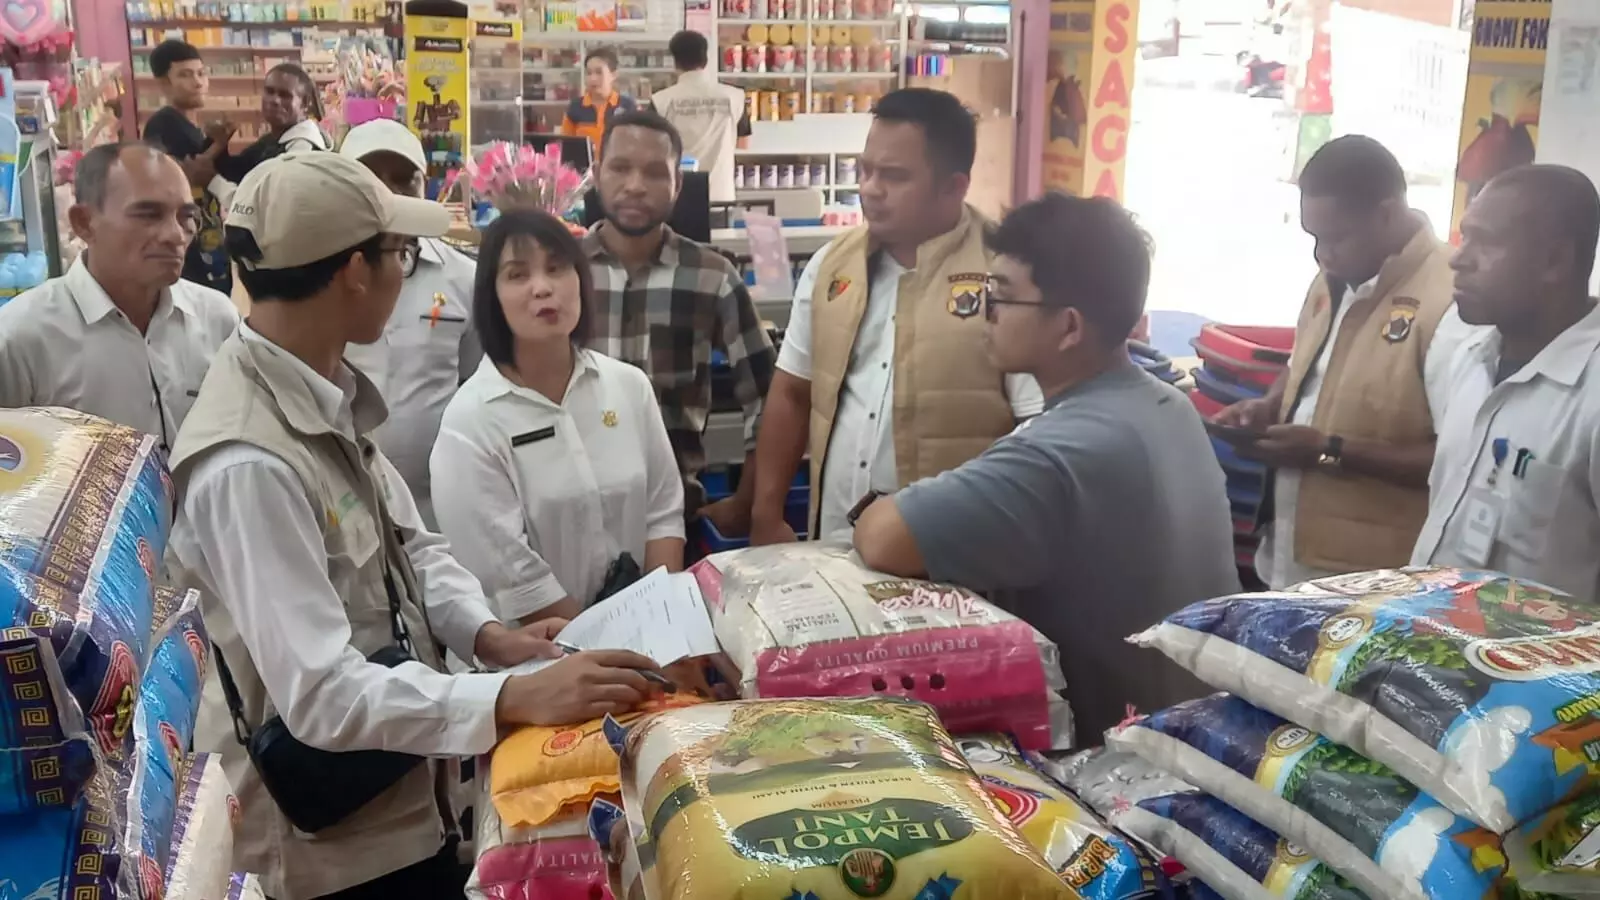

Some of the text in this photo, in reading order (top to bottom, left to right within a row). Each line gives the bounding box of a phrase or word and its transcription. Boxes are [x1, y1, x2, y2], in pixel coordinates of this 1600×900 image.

[812, 636, 979, 670] PREMIUM QUALITY
[810, 797, 871, 810] PREMIUM
[790, 807, 910, 834] TANI
[758, 818, 954, 857] JEMPOL
